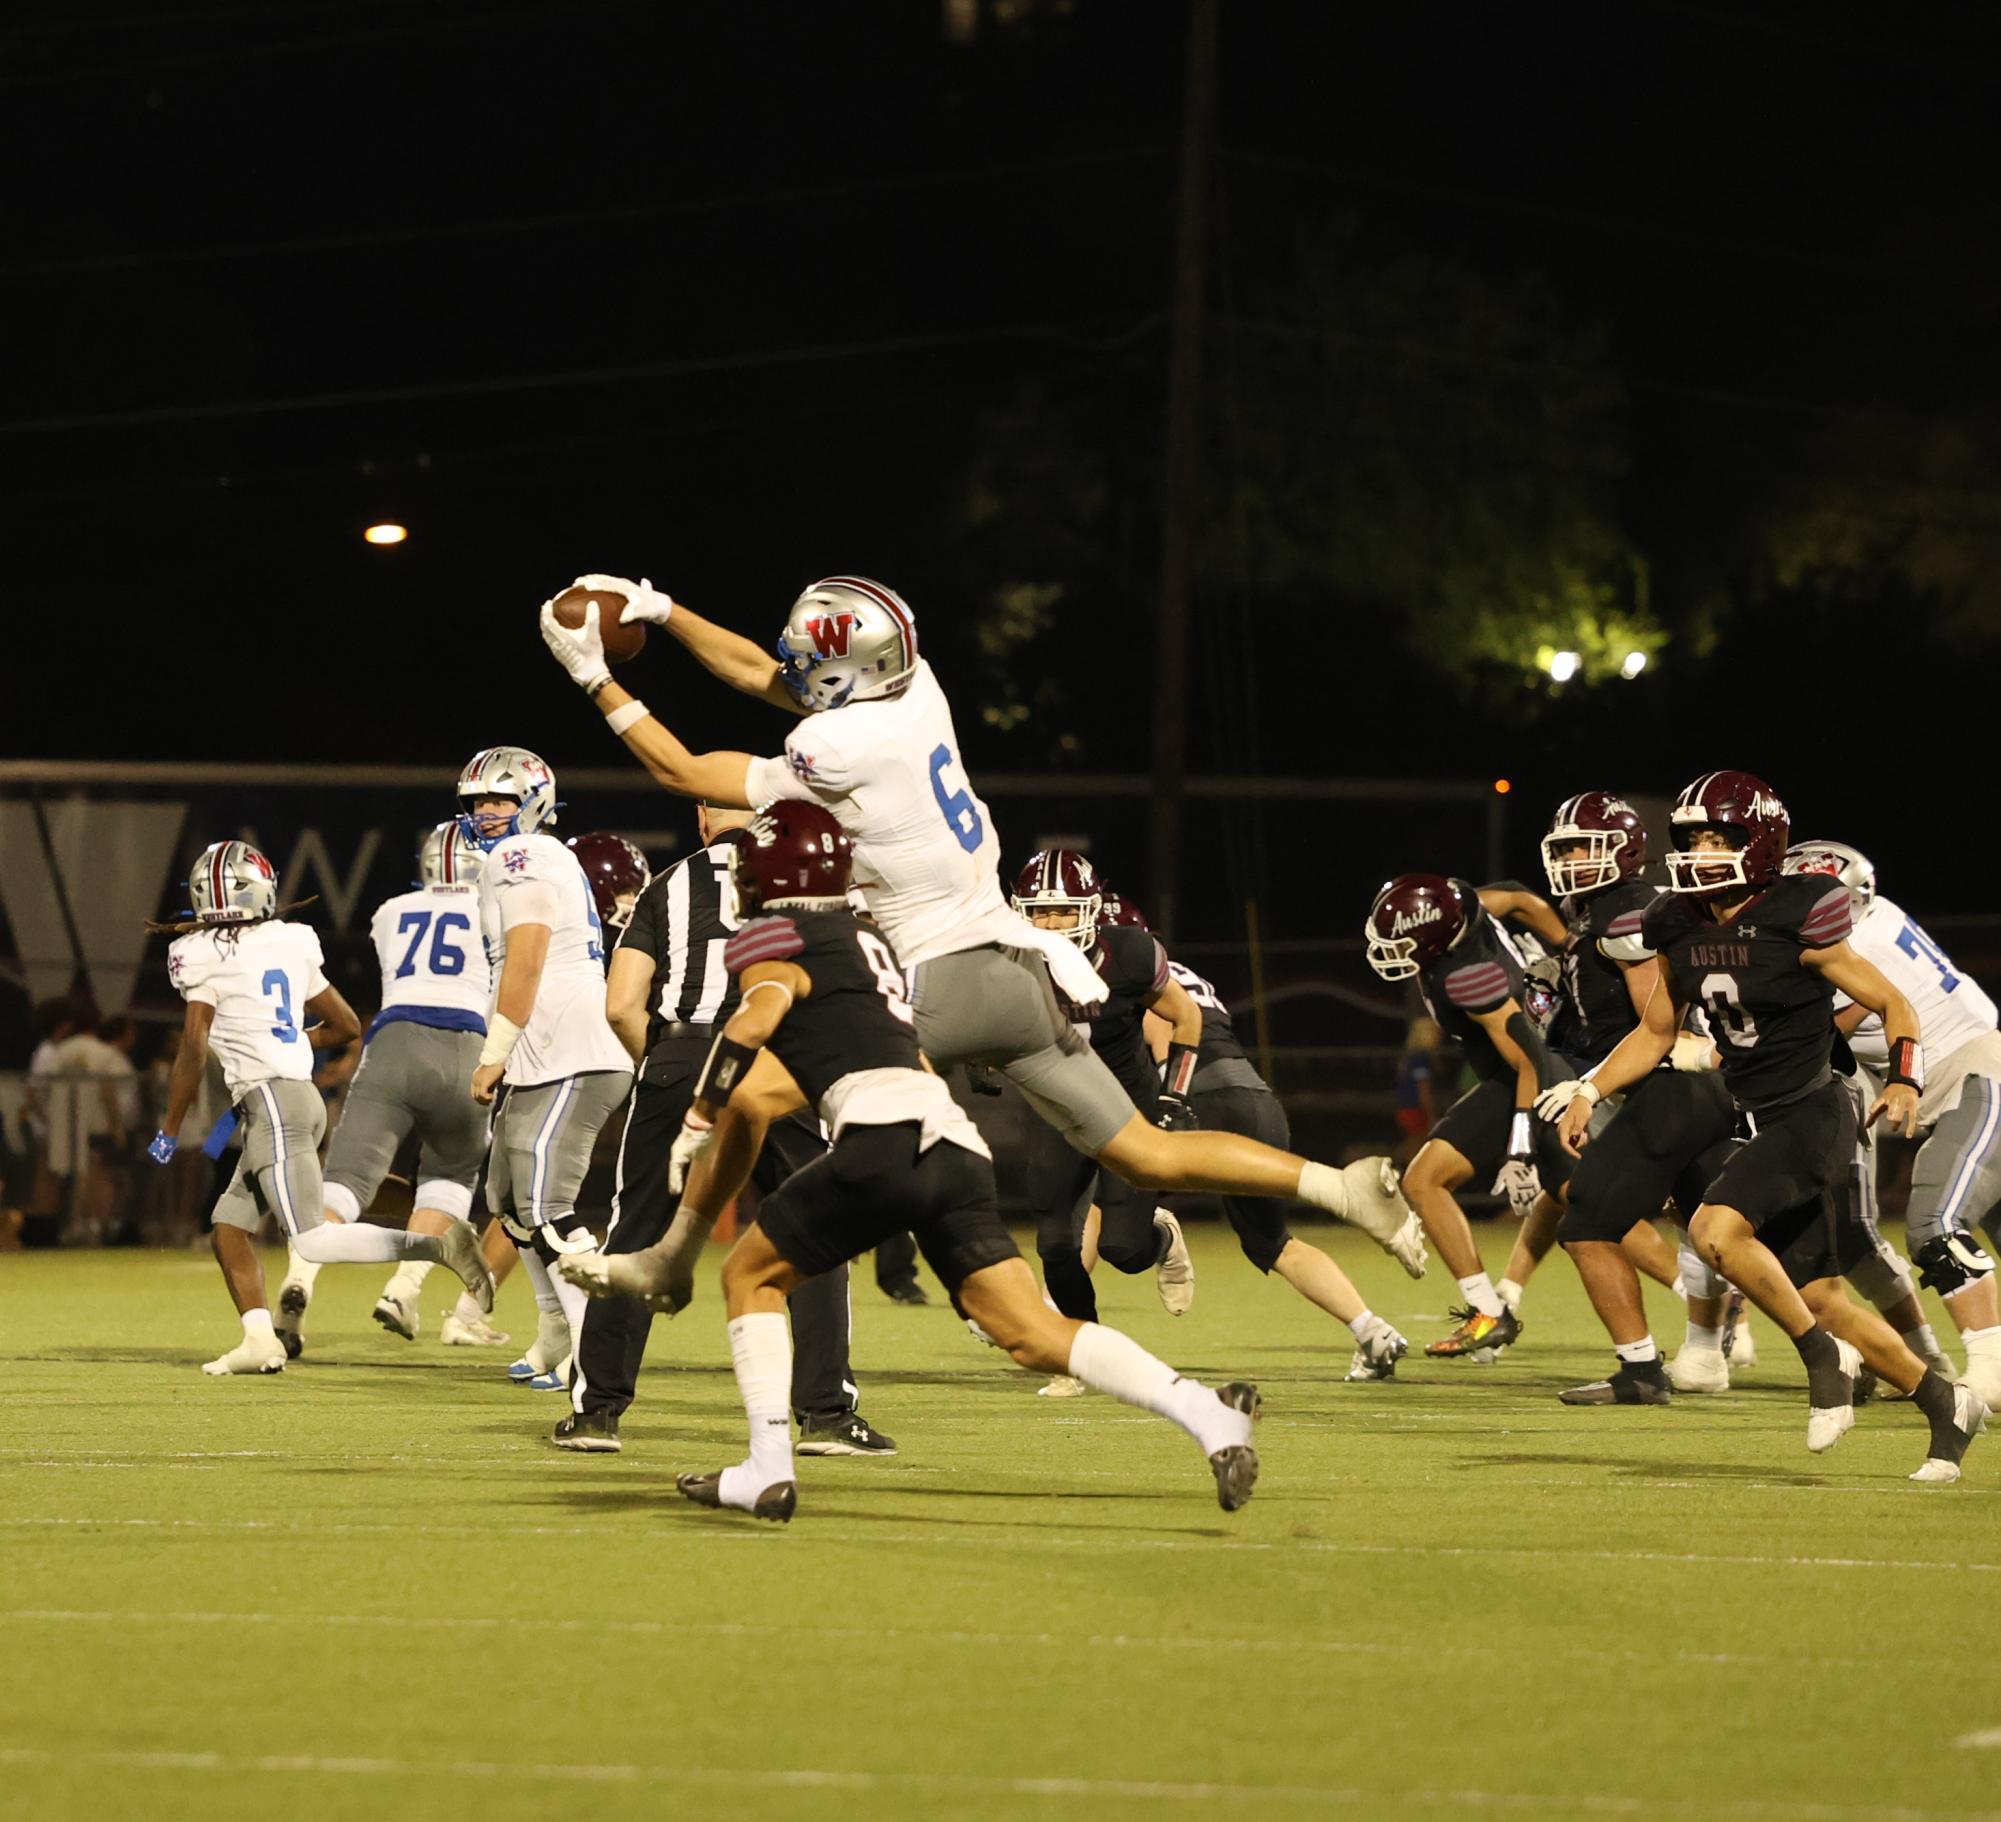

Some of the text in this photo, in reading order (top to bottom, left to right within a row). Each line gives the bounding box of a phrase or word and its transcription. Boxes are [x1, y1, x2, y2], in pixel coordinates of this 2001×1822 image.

[806, 613, 855, 660] W
[930, 743, 983, 854] 6
[820, 832, 834, 854] 8
[395, 911, 470, 979] 76
[1391, 903, 1442, 939] Austin
[857, 929, 914, 1025] 8
[1690, 945, 1749, 967] AUSTIN
[262, 968, 298, 1043] 3
[1701, 973, 1760, 1048] 0
